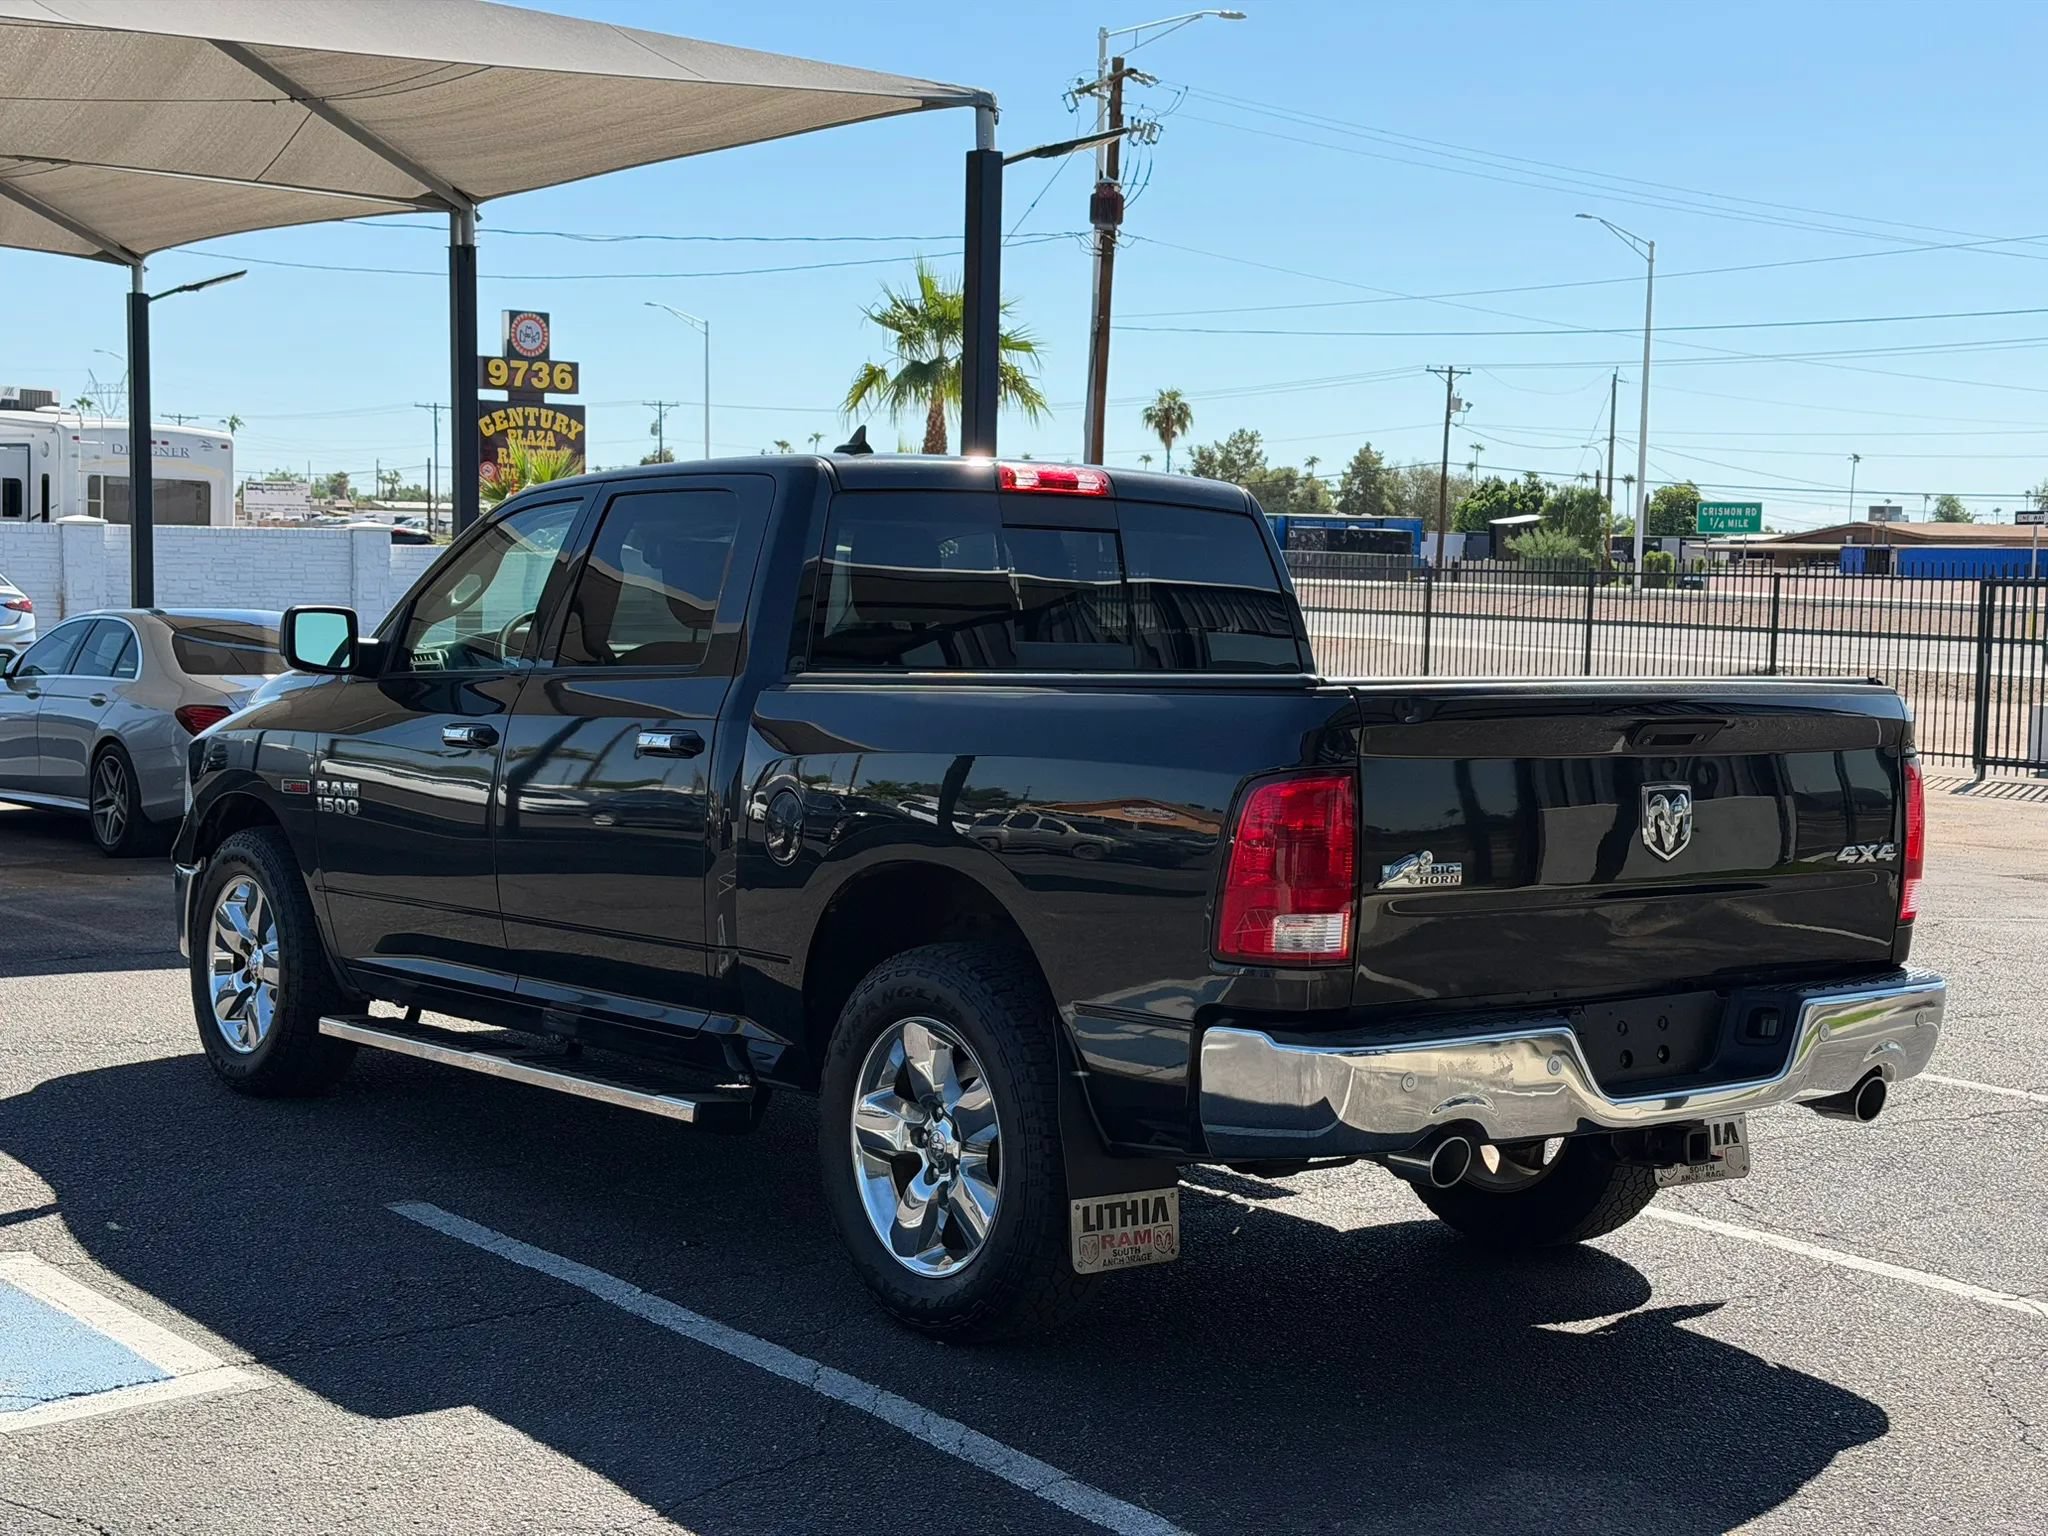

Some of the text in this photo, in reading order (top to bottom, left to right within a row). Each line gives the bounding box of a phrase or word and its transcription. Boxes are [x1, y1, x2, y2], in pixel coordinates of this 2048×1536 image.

[488, 358, 573, 390] 9736
[479, 406, 584, 441] CENTURY
[507, 429, 556, 447] PLAZA
[1702, 507, 1757, 516] CRISMON RD
[1710, 517, 1749, 529] 1/4 MILE
[316, 780, 359, 797] RAM
[316, 796, 359, 815] 1500
[1431, 864, 1455, 874] BIG
[1420, 875, 1459, 884] HORN
[1681, 1170, 1725, 1182] ANCHRAGE
[1689, 1164, 1715, 1174] SOUTH
[1082, 1196, 1170, 1233] LITHIA
[1100, 1228, 1152, 1250] RAM
[1112, 1246, 1141, 1258] SOUTH
